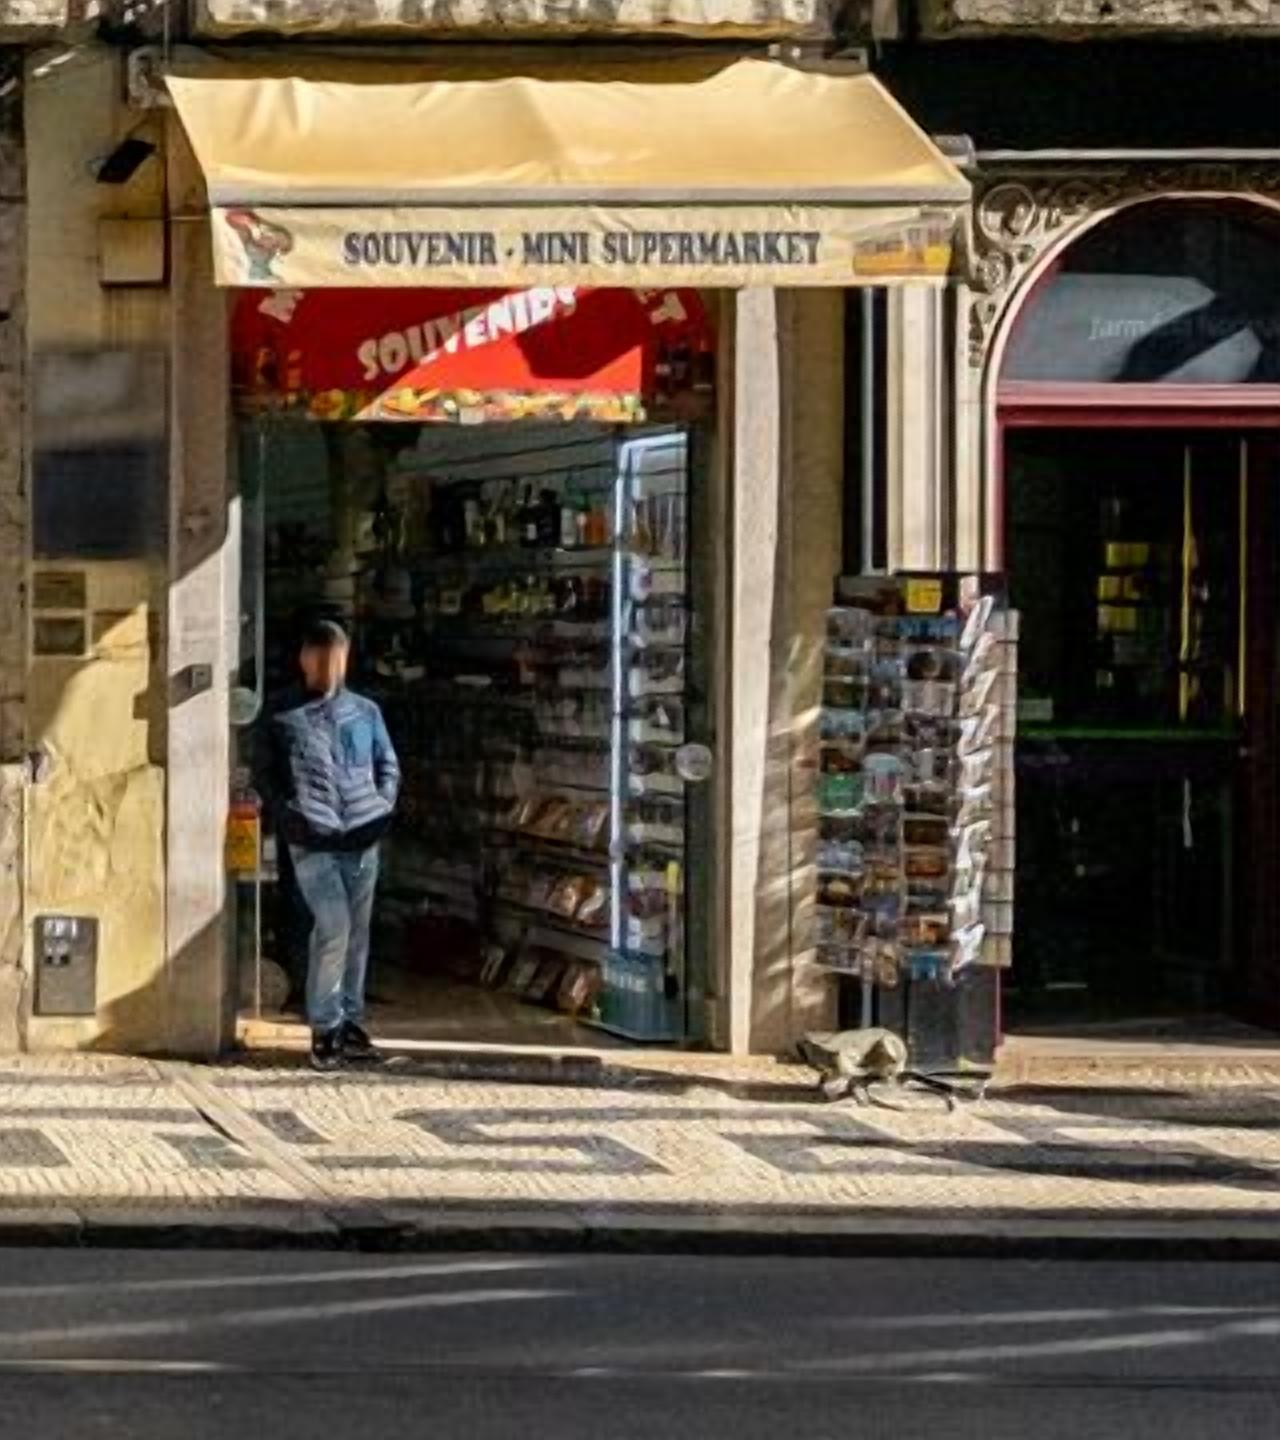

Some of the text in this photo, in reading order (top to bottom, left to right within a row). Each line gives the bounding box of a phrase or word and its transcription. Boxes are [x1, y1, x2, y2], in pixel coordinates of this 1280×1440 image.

[343, 230, 821, 266] SOUVENIR MINI SUPERMARKET
